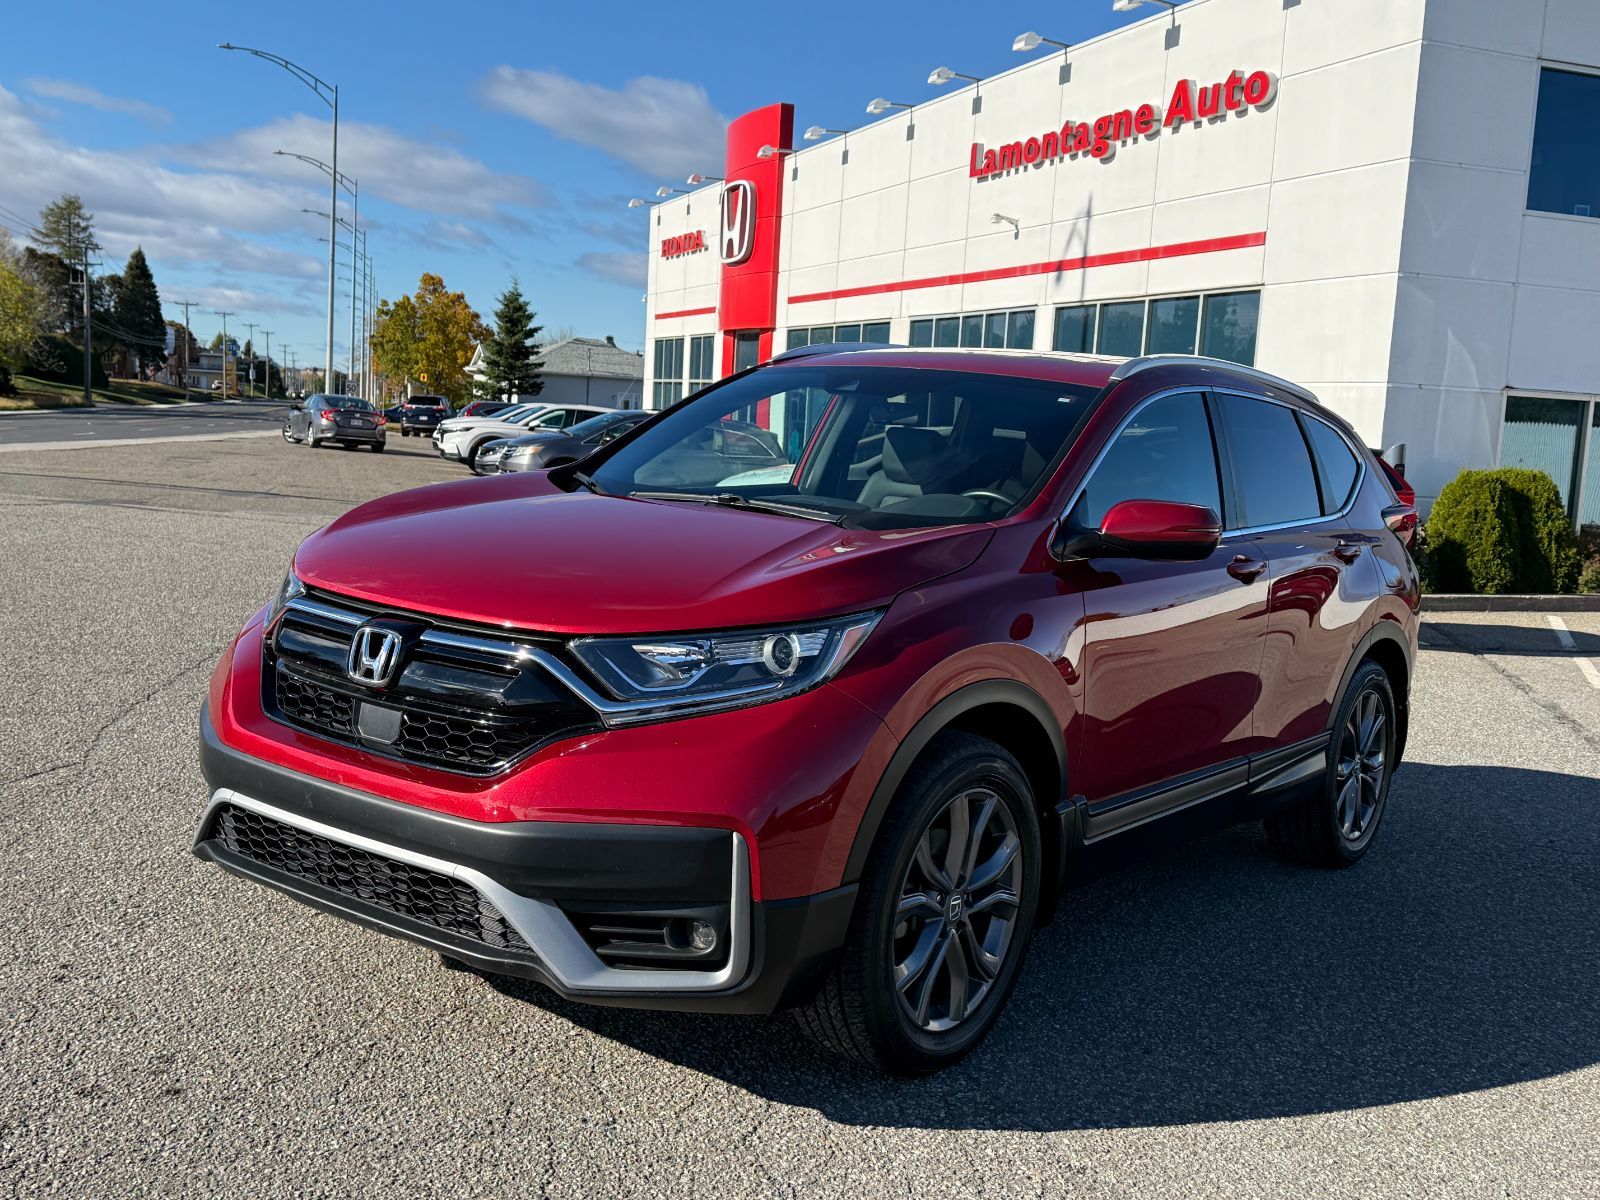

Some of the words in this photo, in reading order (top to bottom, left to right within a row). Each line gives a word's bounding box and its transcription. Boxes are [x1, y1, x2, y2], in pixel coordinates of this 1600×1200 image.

[969, 104, 1155, 178] Lamontagne
[1163, 70, 1272, 128] Auto
[661, 229, 705, 258] HONDA
[346, 383, 357, 392] 50
